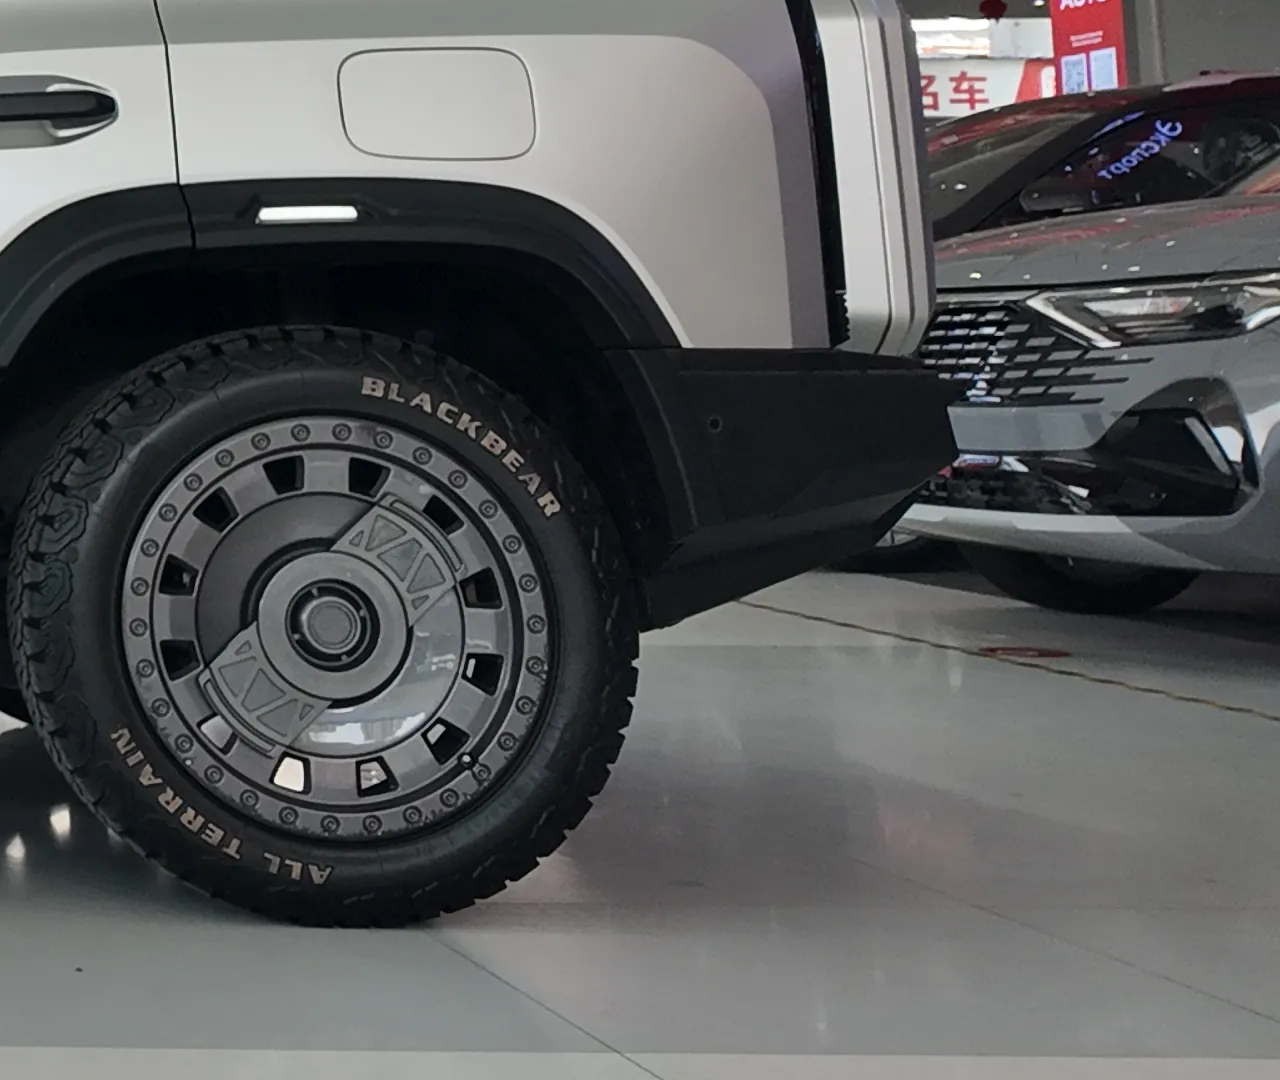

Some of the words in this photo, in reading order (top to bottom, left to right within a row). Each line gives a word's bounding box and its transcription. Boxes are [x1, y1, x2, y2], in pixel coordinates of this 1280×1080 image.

[361, 376, 561, 517] BLACKBEAR
[109, 726, 244, 860] TERRAIN
[263, 852, 332, 885] ALL
